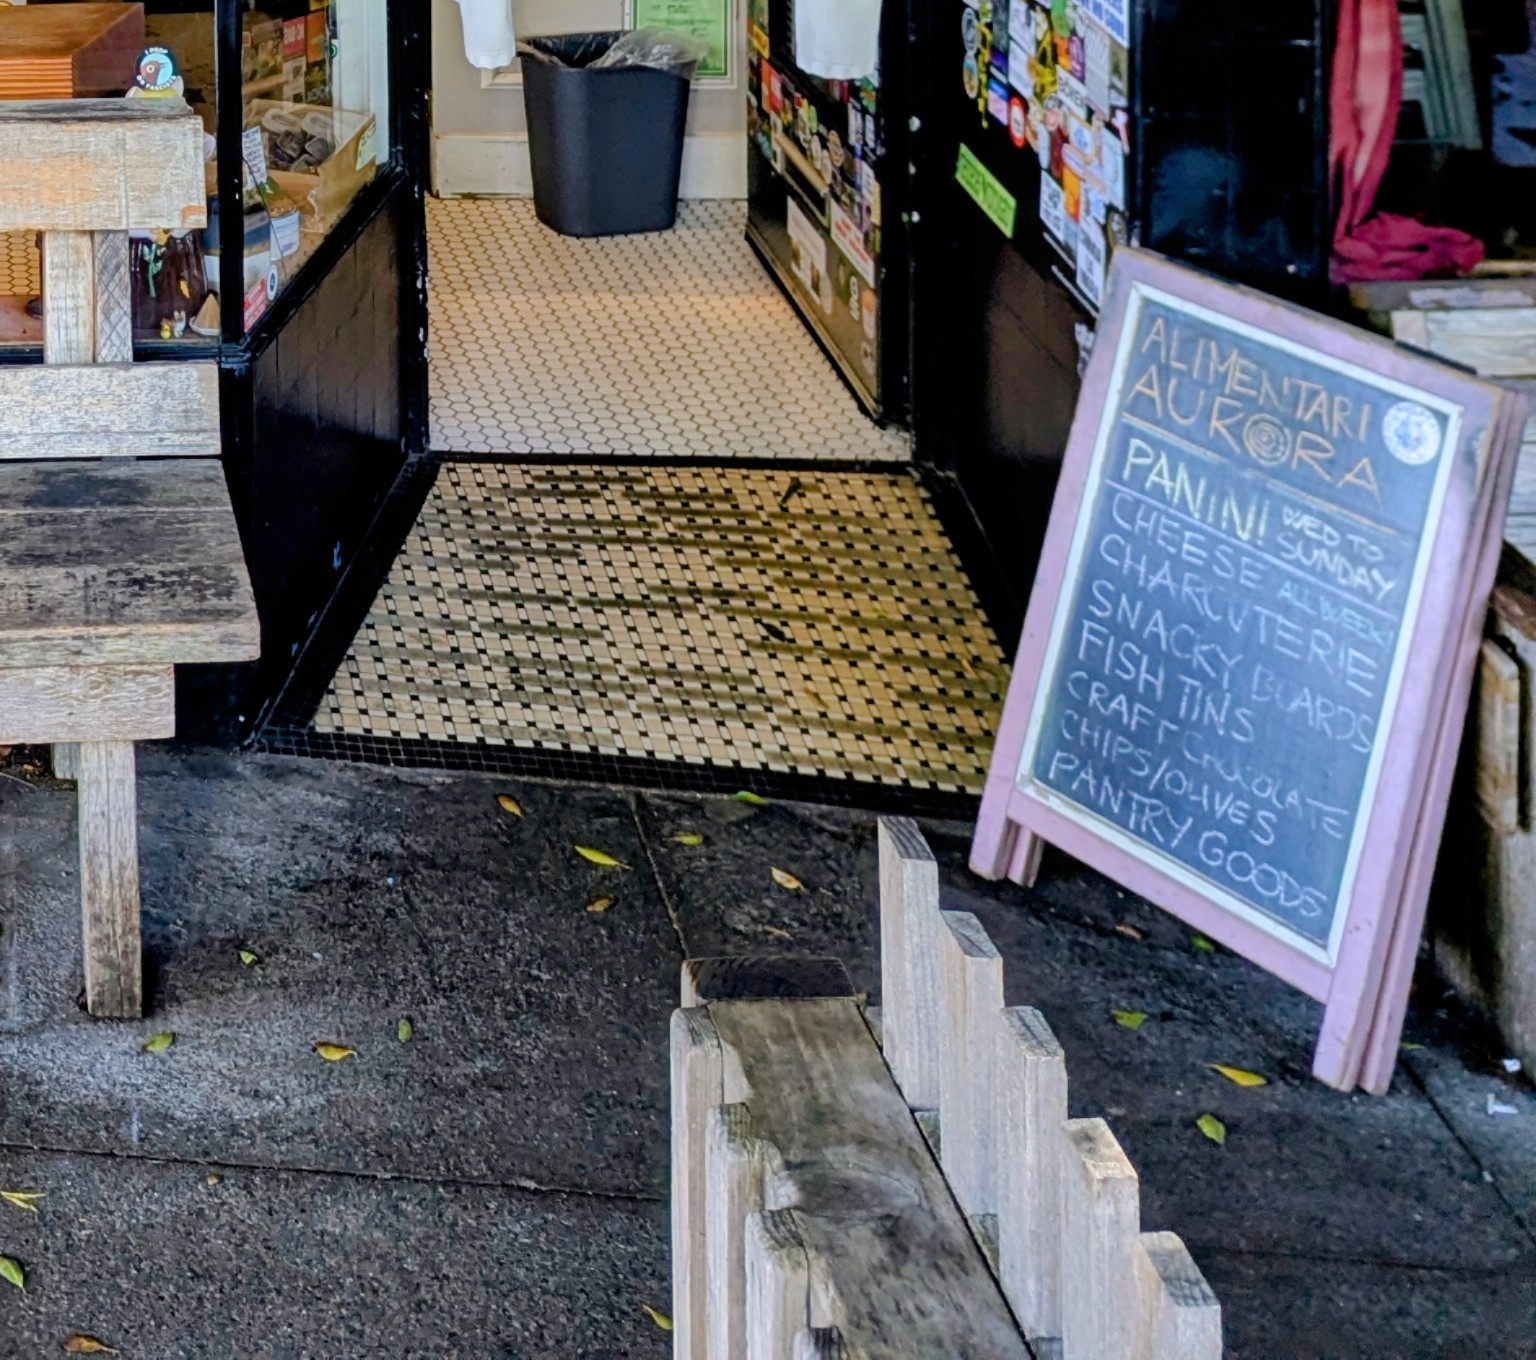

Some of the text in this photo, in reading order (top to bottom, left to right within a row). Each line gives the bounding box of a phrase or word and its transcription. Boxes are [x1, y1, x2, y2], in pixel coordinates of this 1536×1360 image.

[1142, 317, 1370, 442] ALIMENTARI
[1125, 364, 1383, 508] AURORA
[1112, 492, 1270, 590] CHEESE
[1276, 530, 1397, 602] SUNDAY
[1282, 506, 1385, 562] WED TO
[1087, 580, 1244, 690] SNACKY
[1099, 533, 1377, 698] CHARCUTERIE
[1277, 581, 1316, 616] ALL
[1066, 671, 1179, 745] CRAFT
[1078, 619, 1256, 743] FISH TINS
[1048, 750, 1328, 918] PANTRY GOODS
